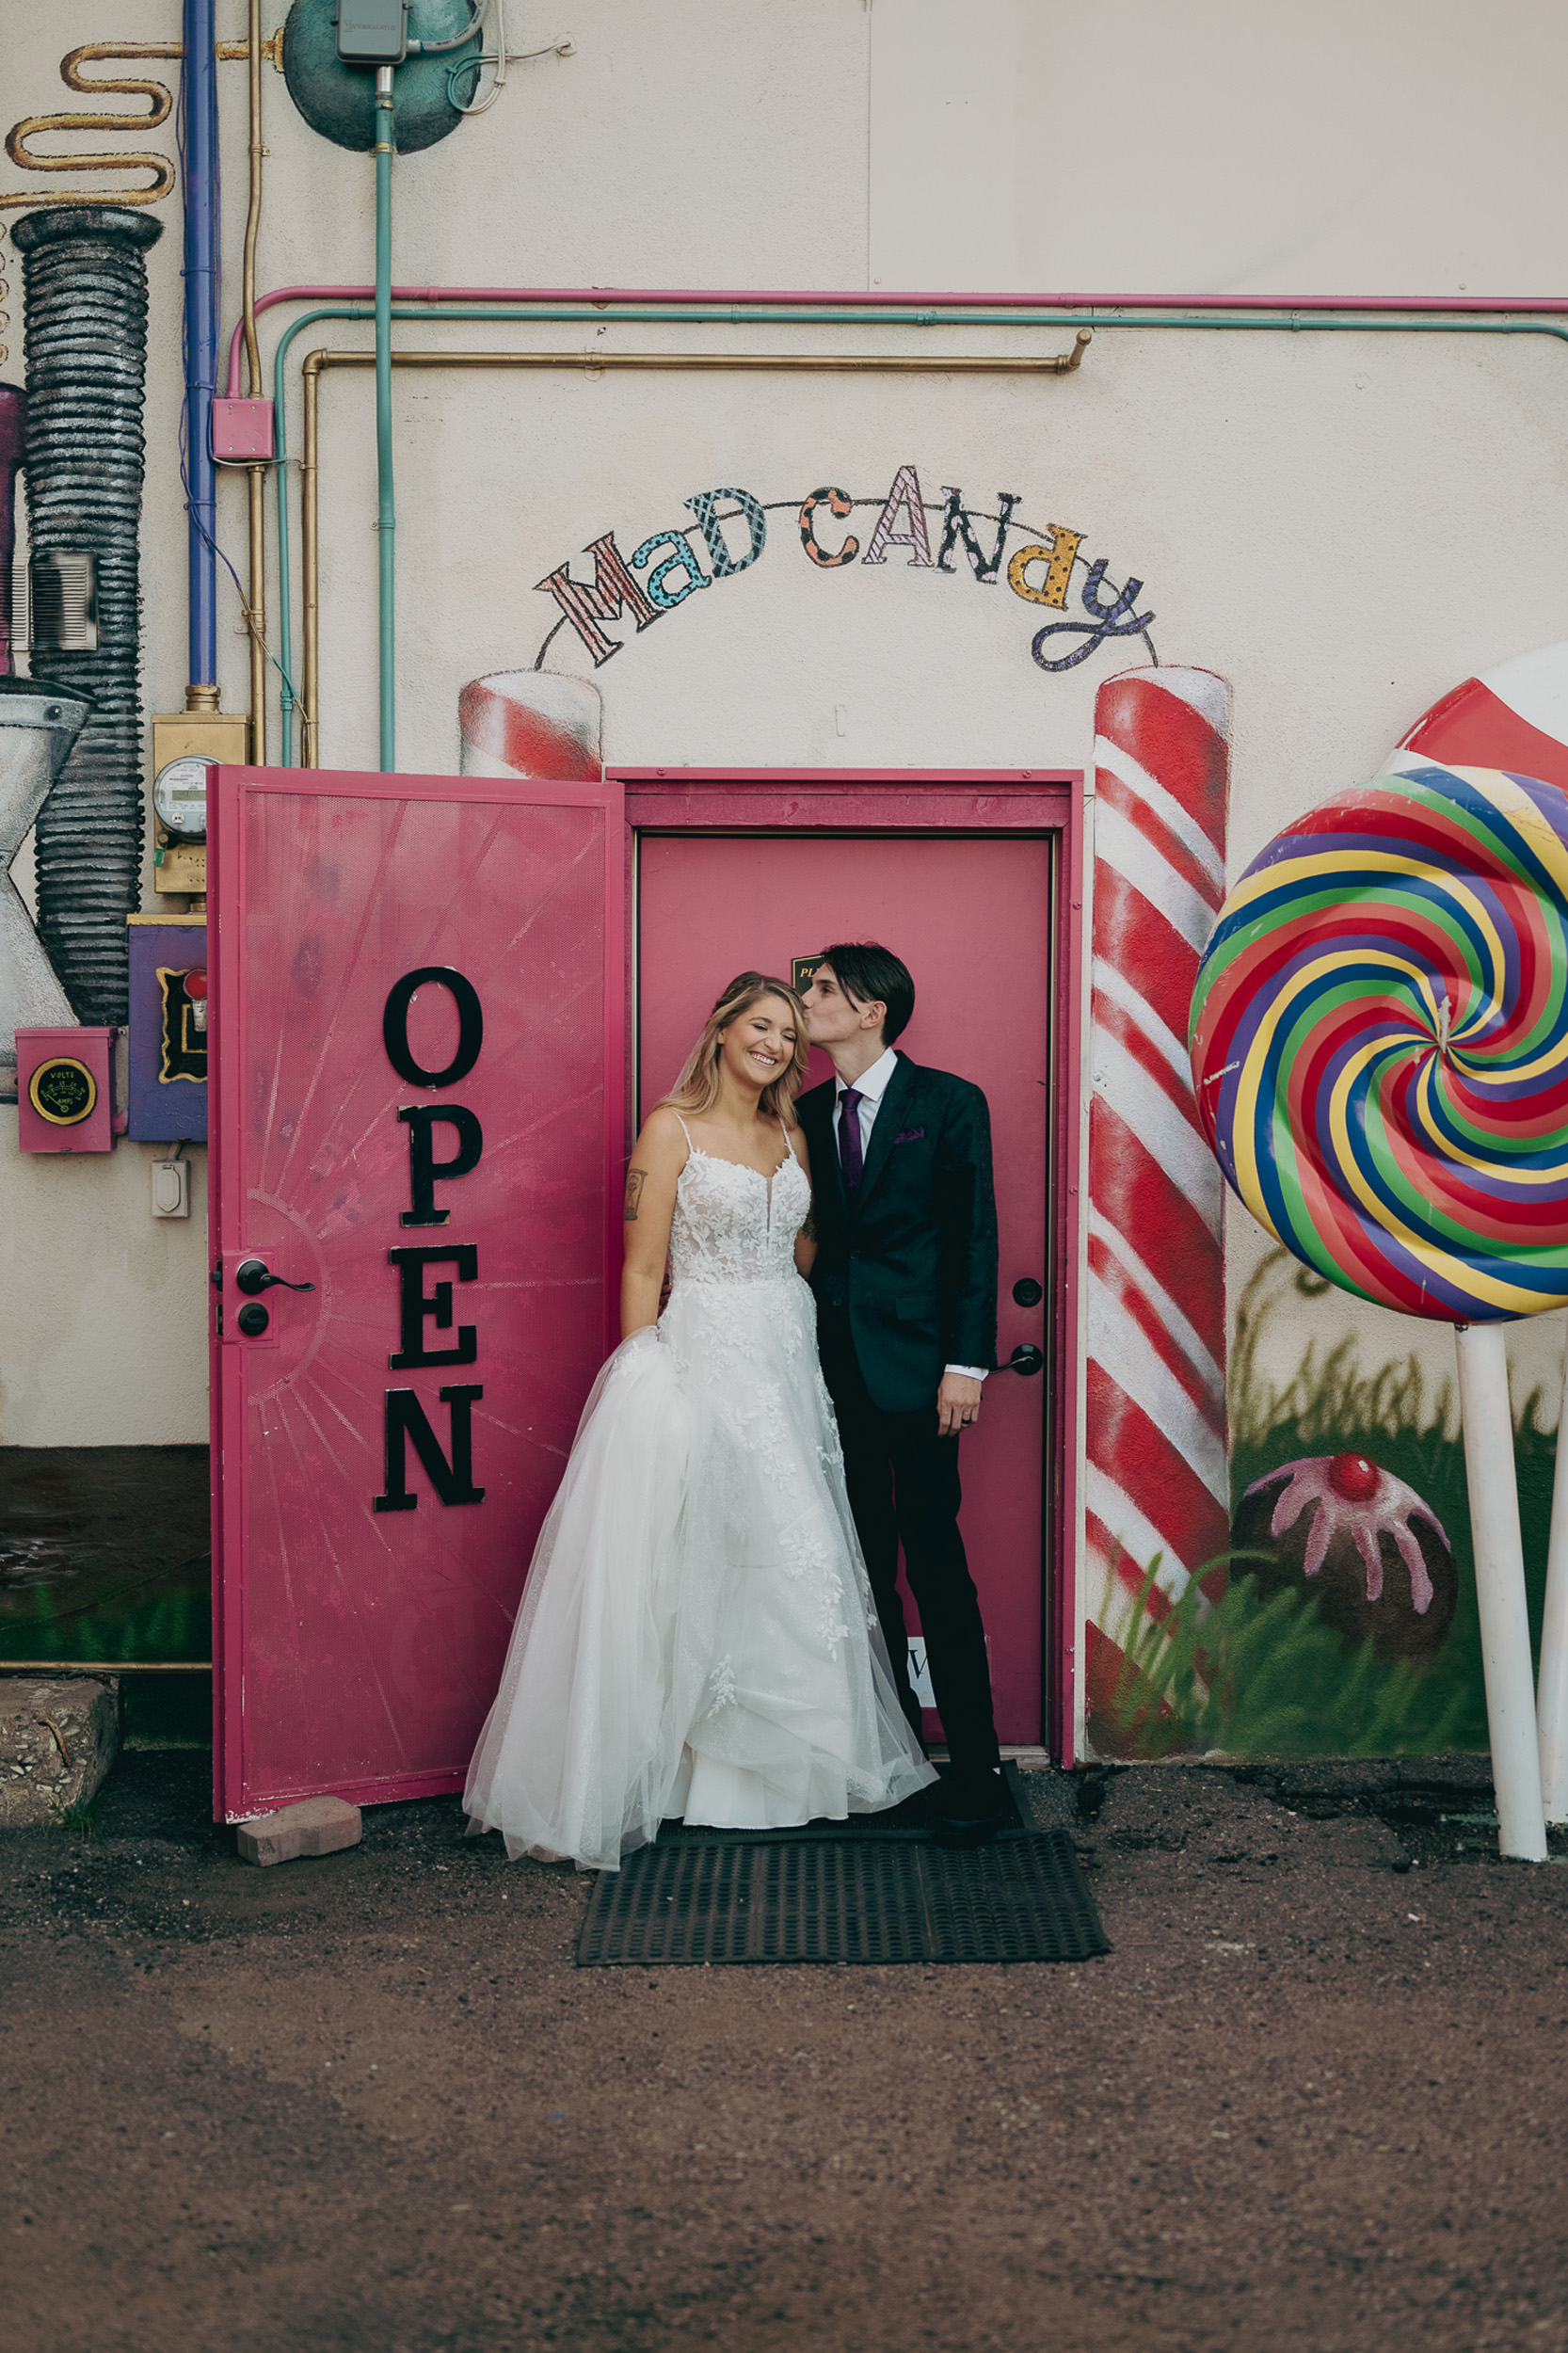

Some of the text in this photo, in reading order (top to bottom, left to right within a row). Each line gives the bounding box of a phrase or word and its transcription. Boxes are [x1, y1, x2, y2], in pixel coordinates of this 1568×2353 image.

[533, 464, 1156, 673] MaD CANdy
[372, 966, 486, 1513] OPEN
